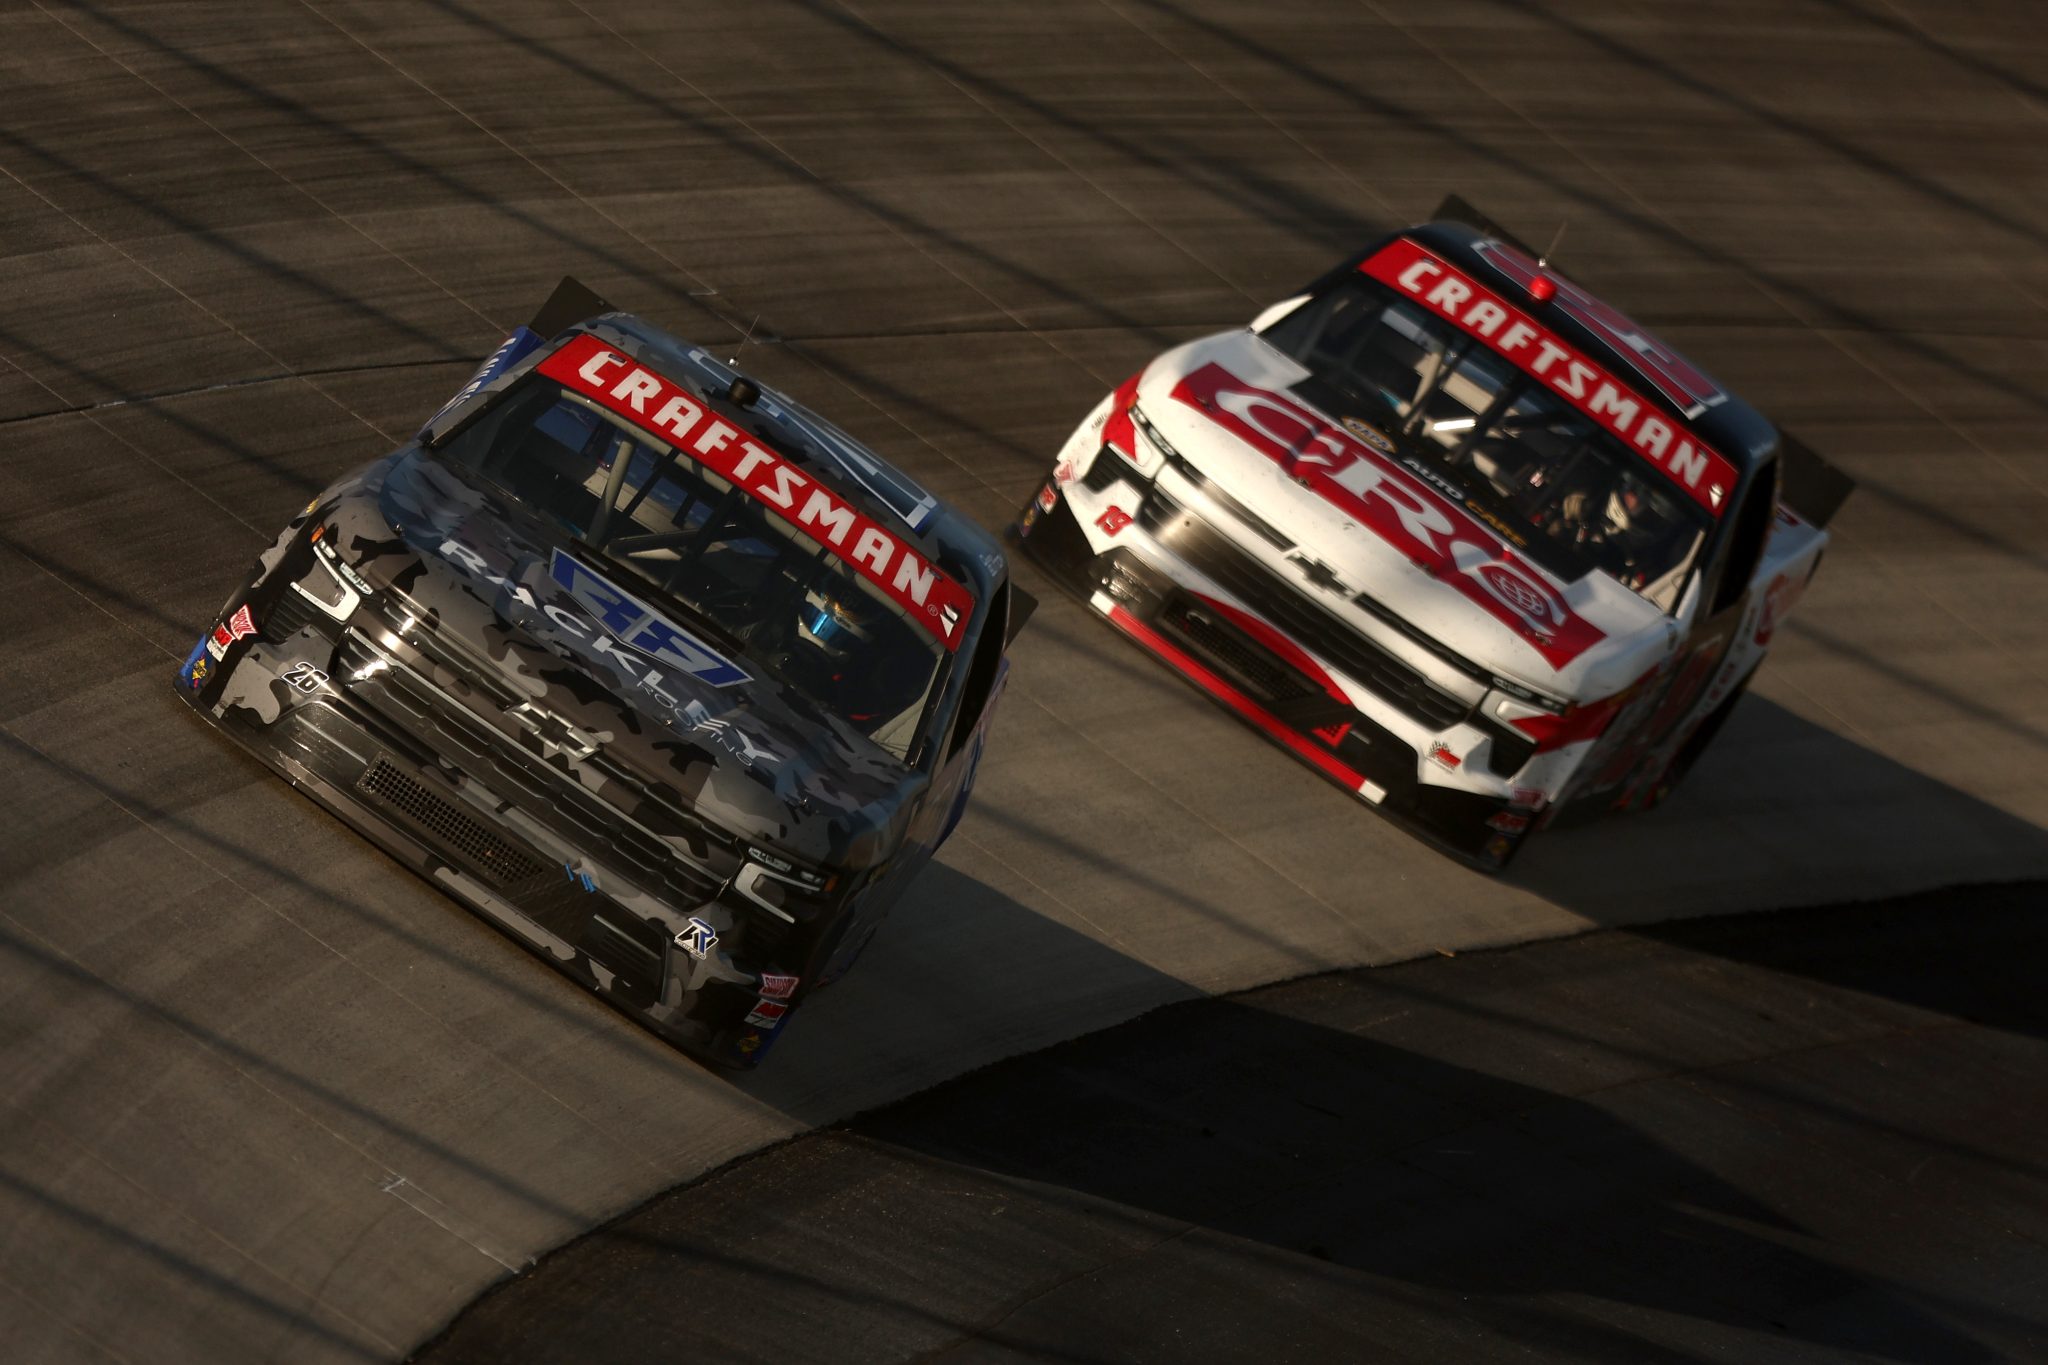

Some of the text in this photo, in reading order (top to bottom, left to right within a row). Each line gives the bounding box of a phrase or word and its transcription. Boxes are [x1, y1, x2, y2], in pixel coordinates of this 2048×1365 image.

[578, 350, 940, 607] CRAFTSMAN
[1398, 258, 1708, 488] CRAFTSMAN
[1216, 389, 1567, 635] CRC
[1402, 460, 1465, 500] AUTO
[1466, 500, 1527, 548] CARE
[281, 661, 330, 694] 26
[439, 537, 781, 763] RACKLEY
